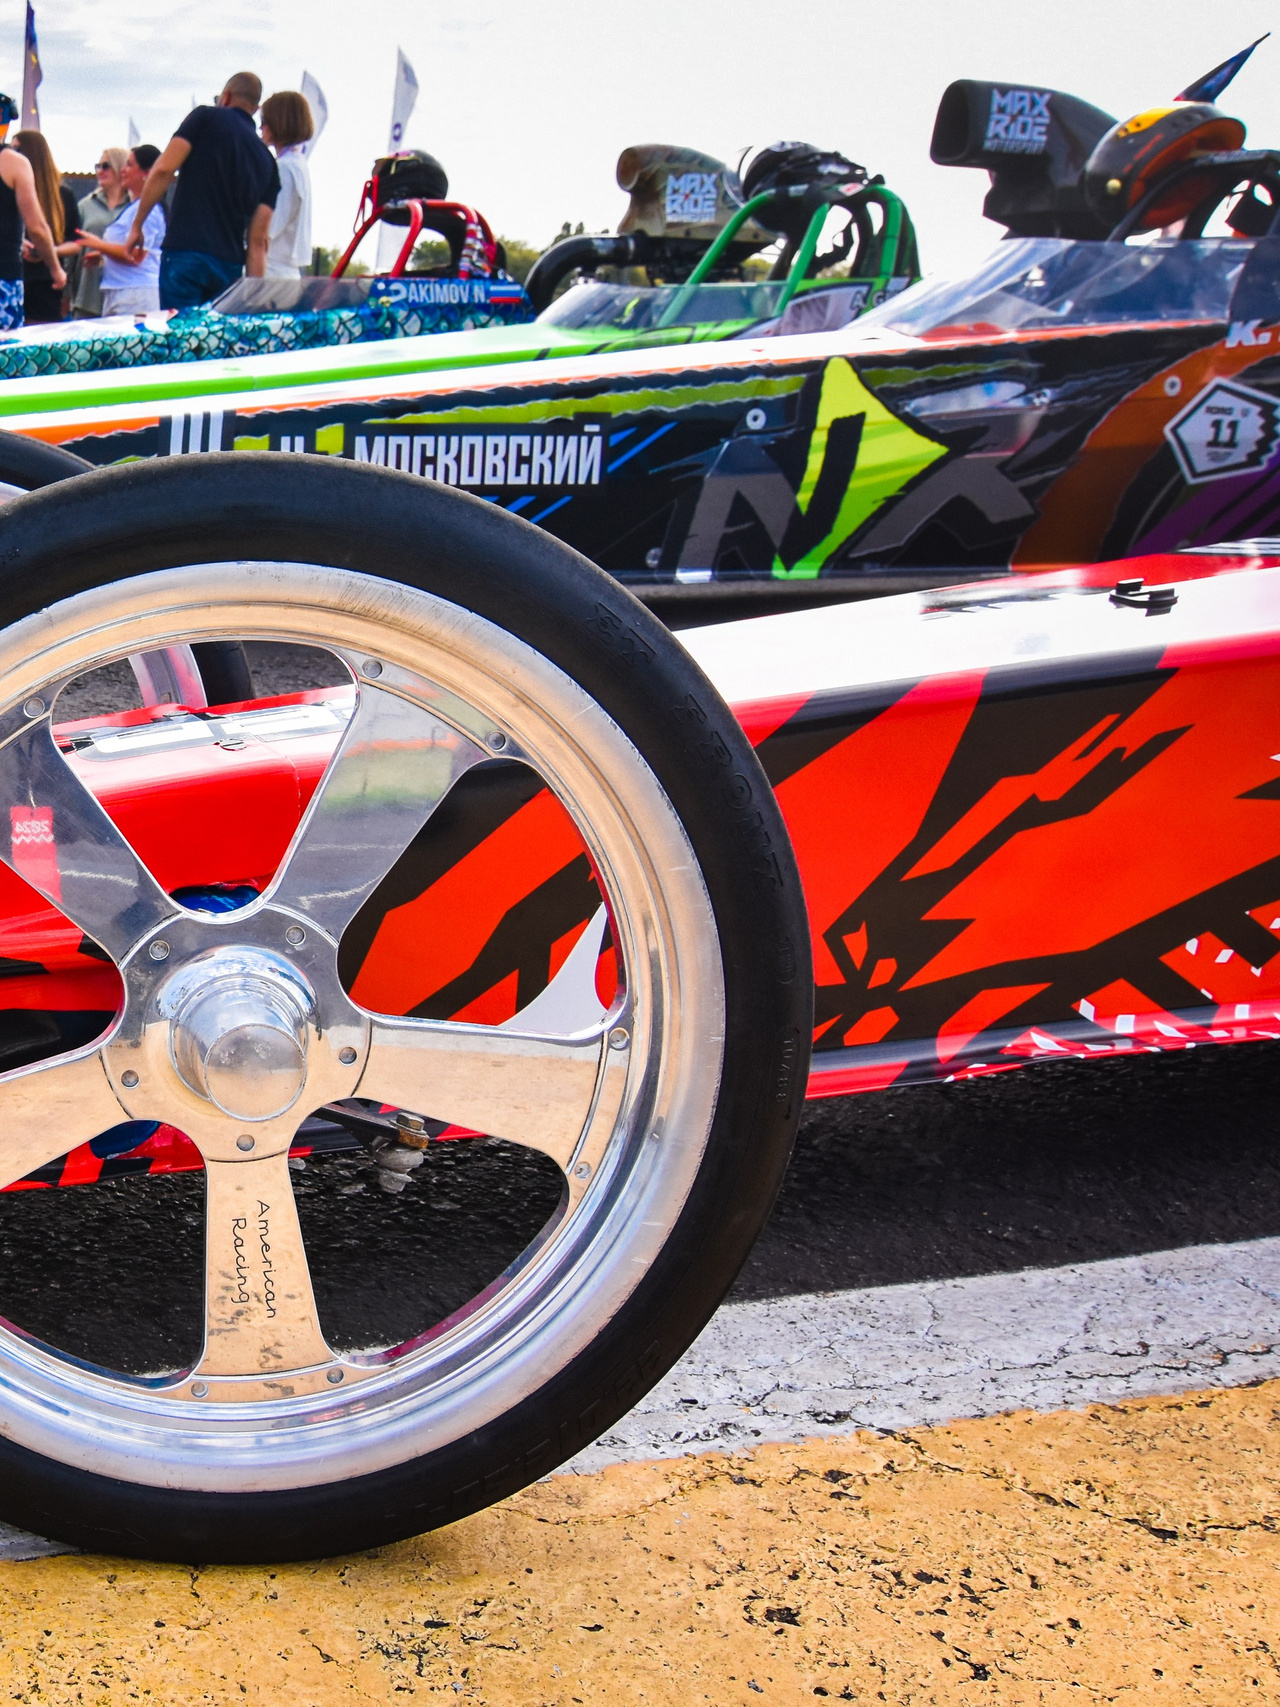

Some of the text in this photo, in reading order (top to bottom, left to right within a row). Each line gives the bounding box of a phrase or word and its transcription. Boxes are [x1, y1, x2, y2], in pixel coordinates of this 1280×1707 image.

[990, 88, 1052, 118] MAX
[666, 173, 718, 195] MAX
[408, 281, 469, 303] AKIMOV
[1206, 419, 1240, 448] 11
[354, 424, 602, 485] МОСКОВСКИЙ
[230, 1217, 250, 1304] Racing
[256, 1199, 277, 1319] American
